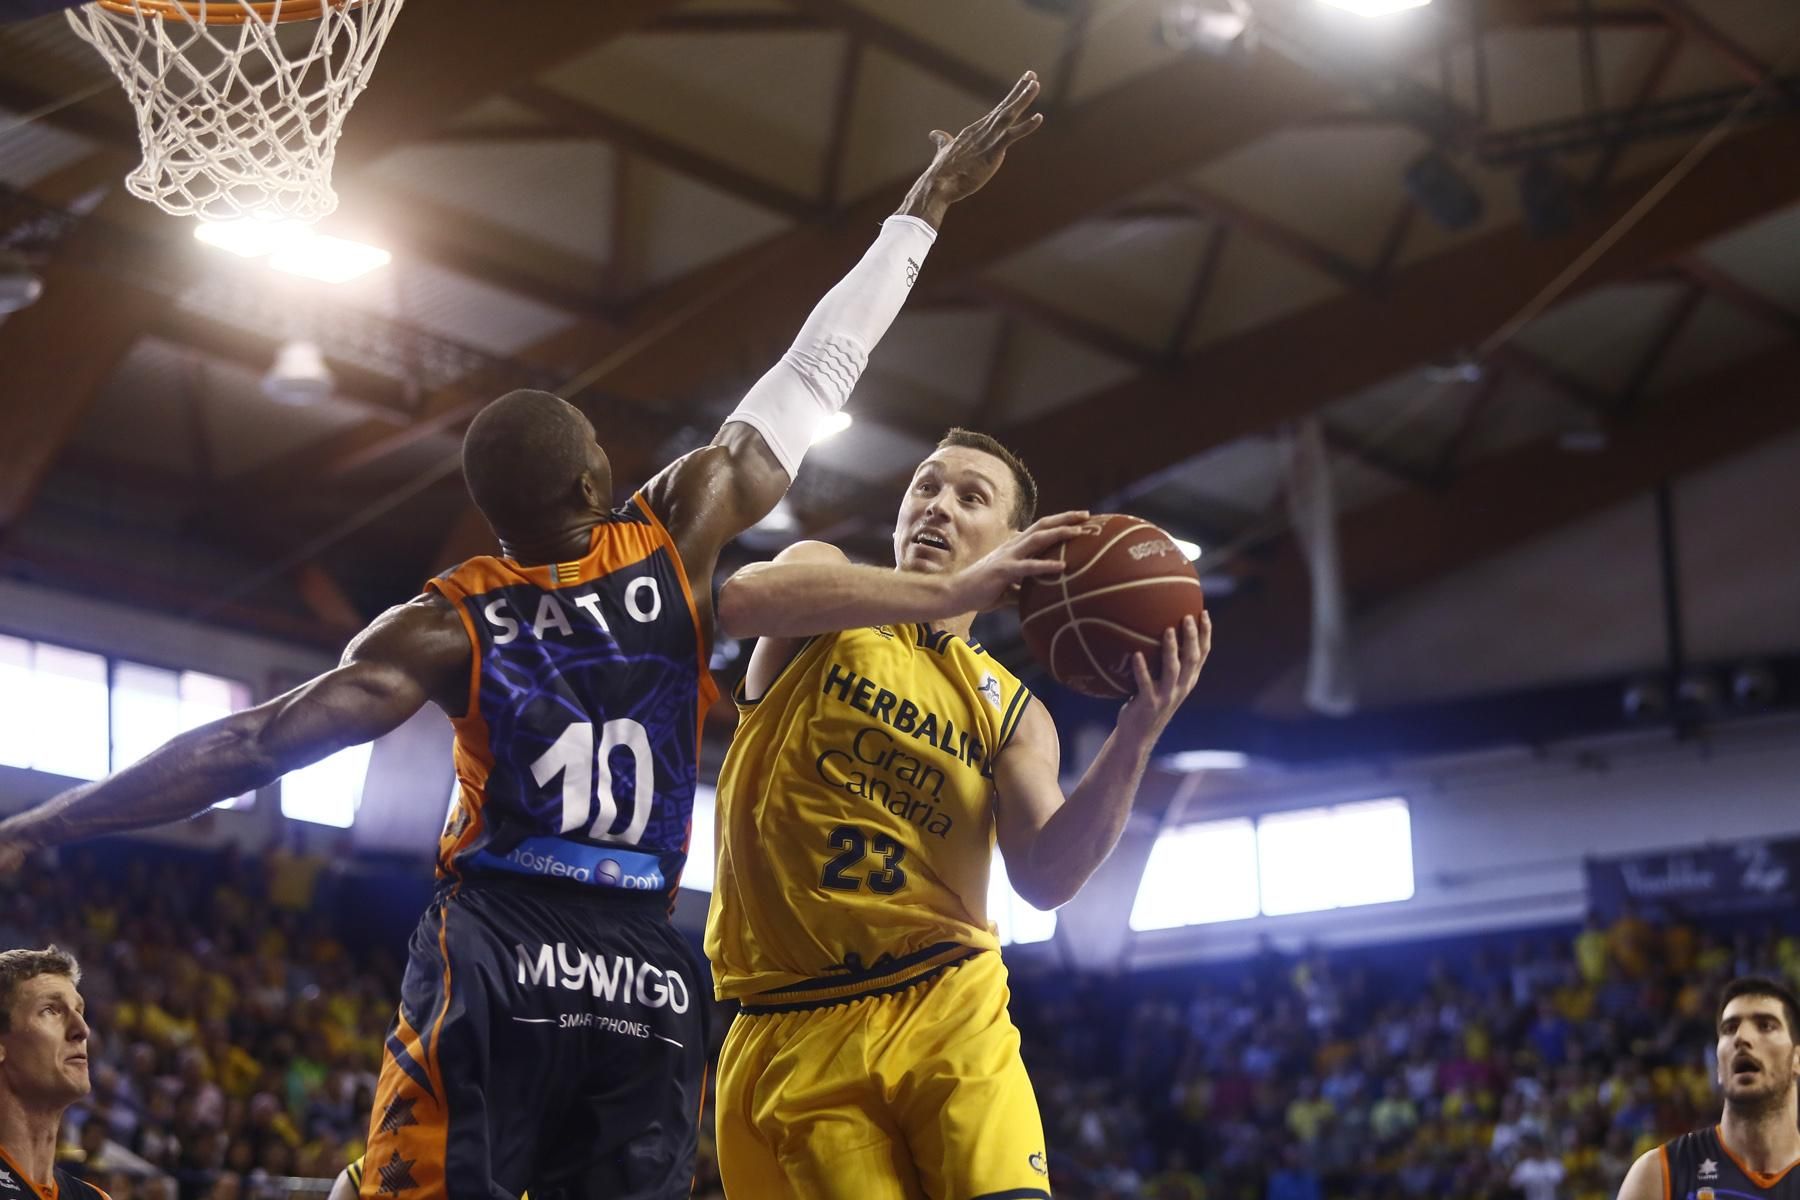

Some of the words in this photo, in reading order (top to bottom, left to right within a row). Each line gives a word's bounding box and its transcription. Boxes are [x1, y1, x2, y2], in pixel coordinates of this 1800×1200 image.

[484, 576, 662, 645] SATO
[530, 717, 655, 845] 10
[816, 749, 953, 840] Canaria
[853, 727, 945, 797] Gran
[819, 823, 908, 895] 23
